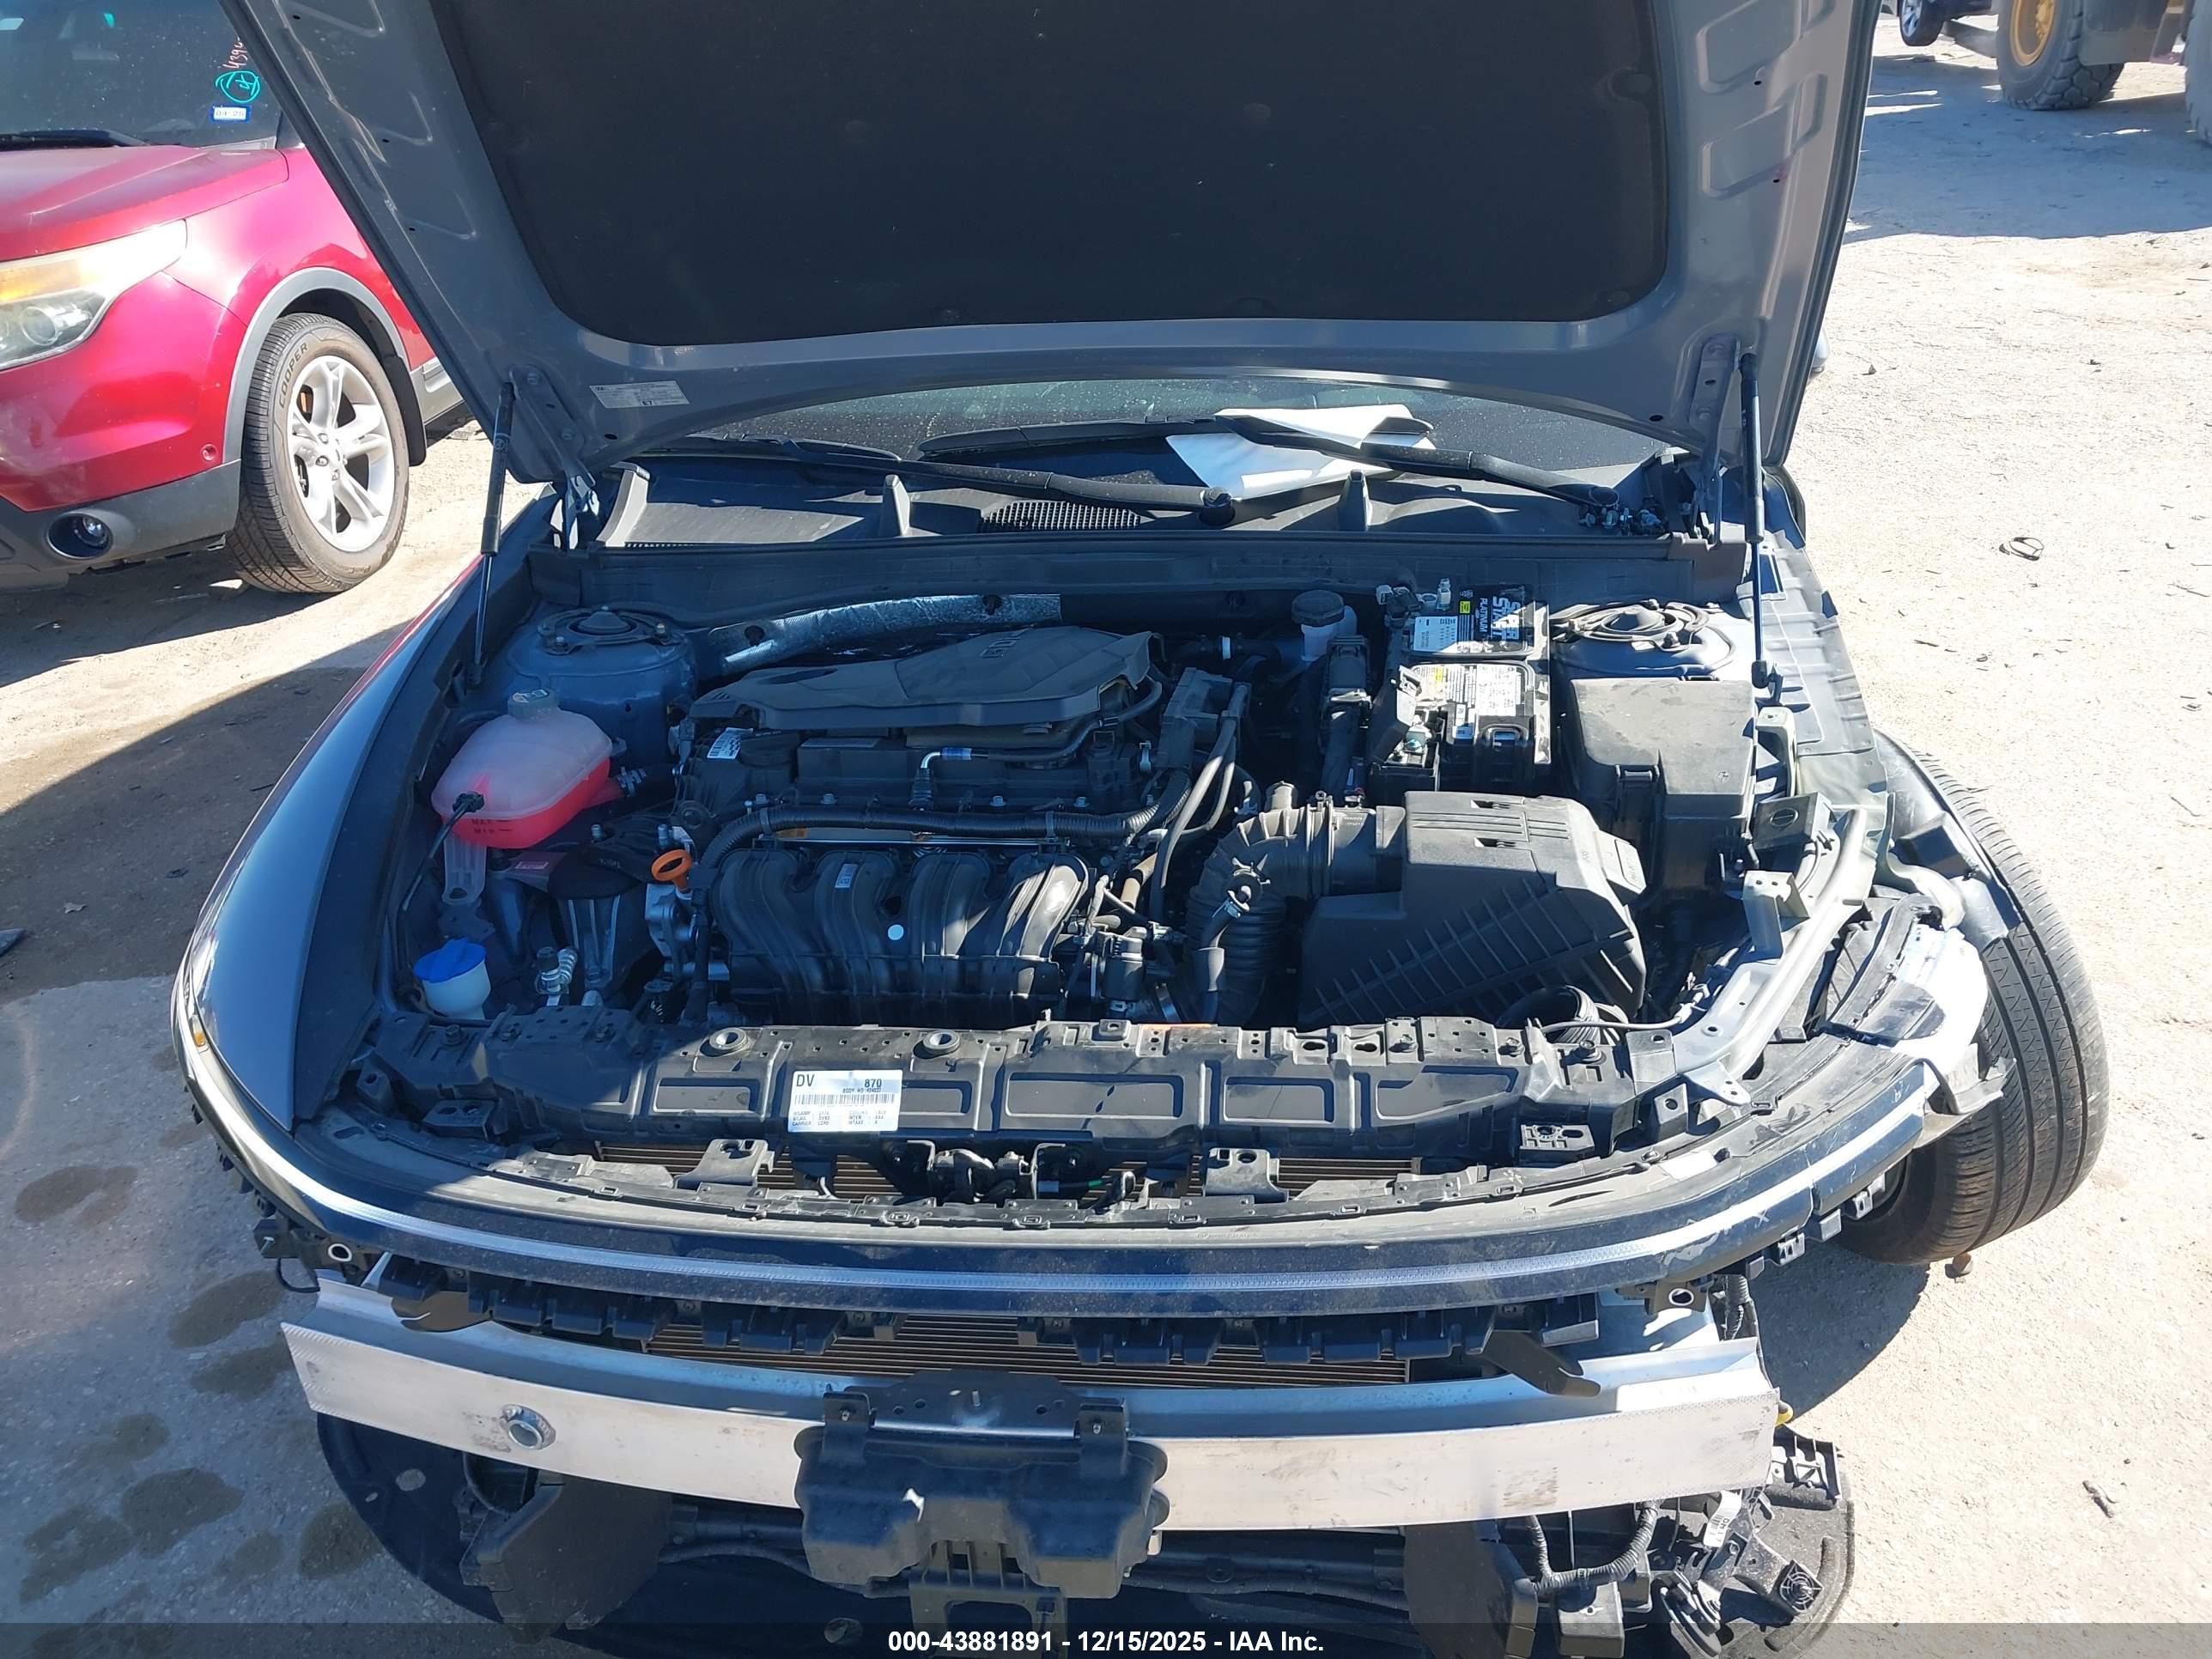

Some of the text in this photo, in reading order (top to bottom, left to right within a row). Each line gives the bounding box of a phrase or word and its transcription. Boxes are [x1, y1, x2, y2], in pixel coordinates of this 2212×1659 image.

[279, 343, 308, 409] COOPER
[1479, 598, 1488, 633] PLATINUM
[1492, 596, 1509, 640] START
[796, 1073, 882, 1088] DV 870
